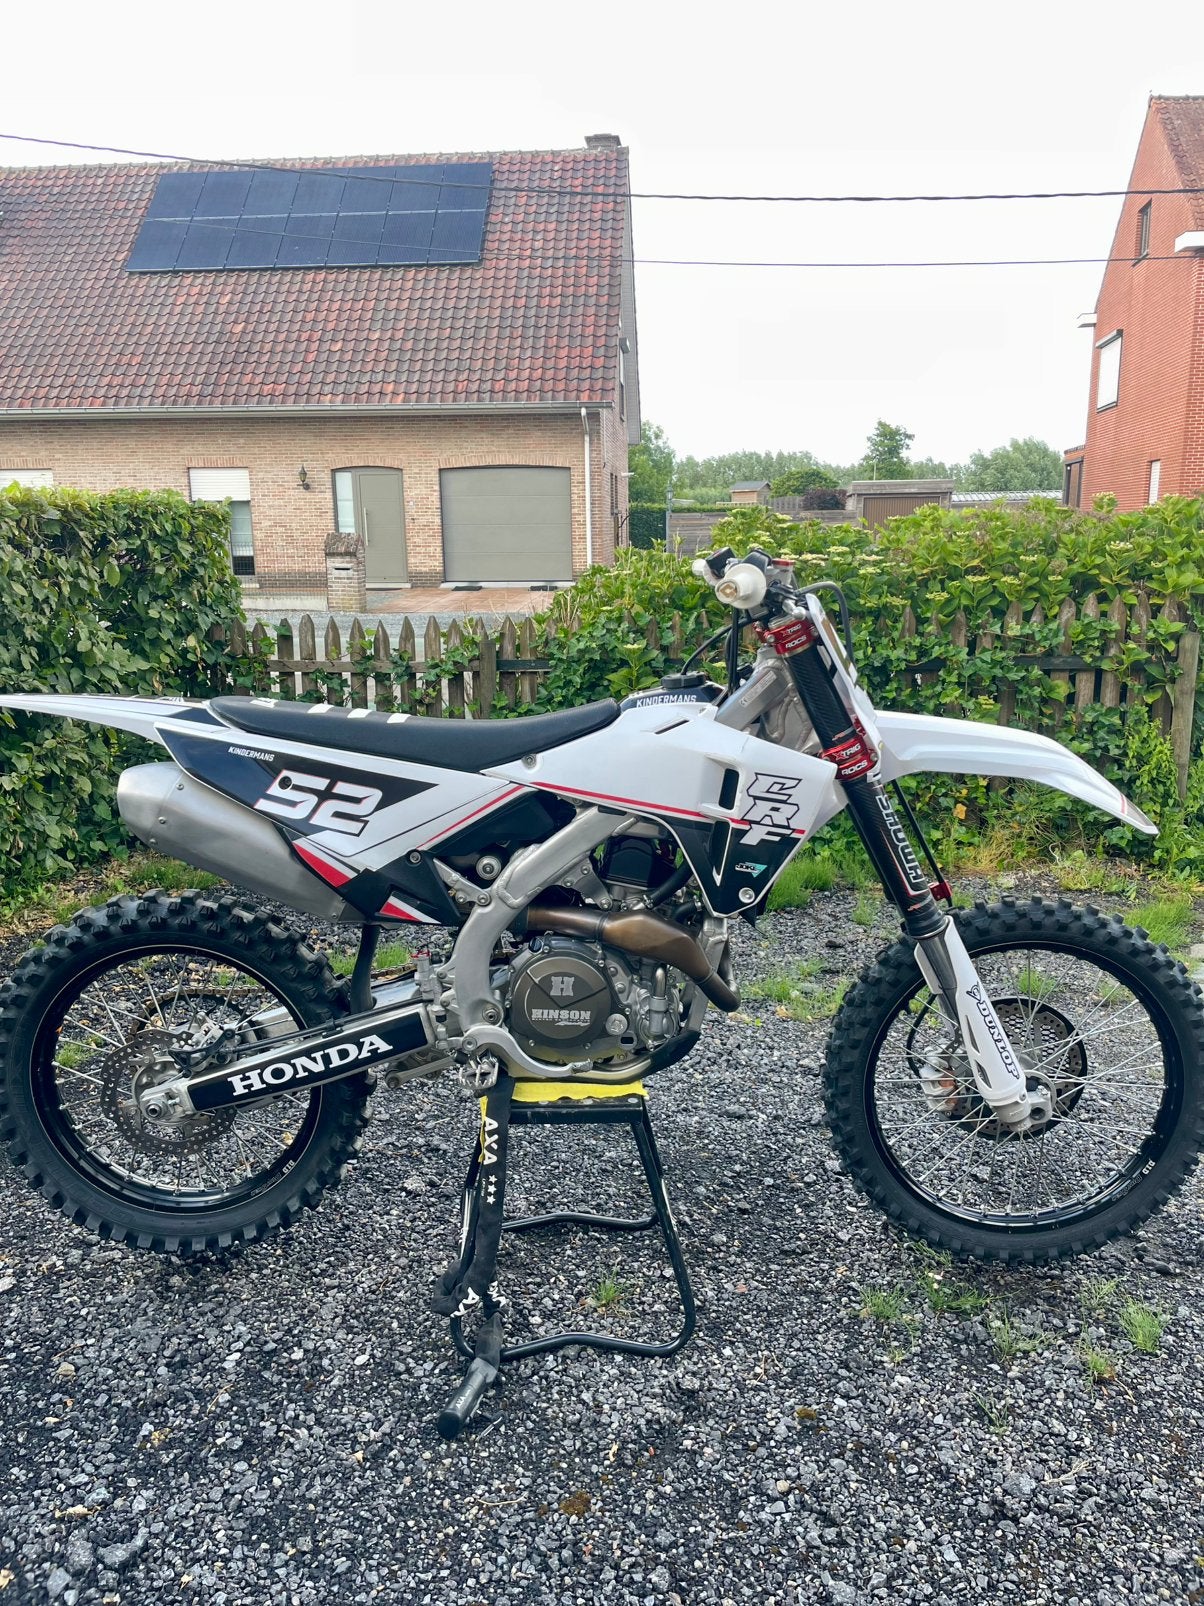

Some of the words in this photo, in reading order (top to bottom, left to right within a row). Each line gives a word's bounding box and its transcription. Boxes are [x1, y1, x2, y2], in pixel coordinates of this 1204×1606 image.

[785, 634, 807, 649] ROCS
[636, 694, 697, 708] KINDERMANS
[228, 746, 275, 762] KINDERMANS
[832, 742, 861, 761] XTRIG
[841, 760, 868, 776] ROCS
[253, 769, 383, 837] 52
[739, 772, 803, 846] CRF
[875, 794, 925, 883] SHOWA
[531, 1008, 591, 1020] HINSON
[976, 1000, 1020, 1079] DUNLOP
[227, 1034, 393, 1096] HONDA
[483, 1116, 499, 1165] AXA
